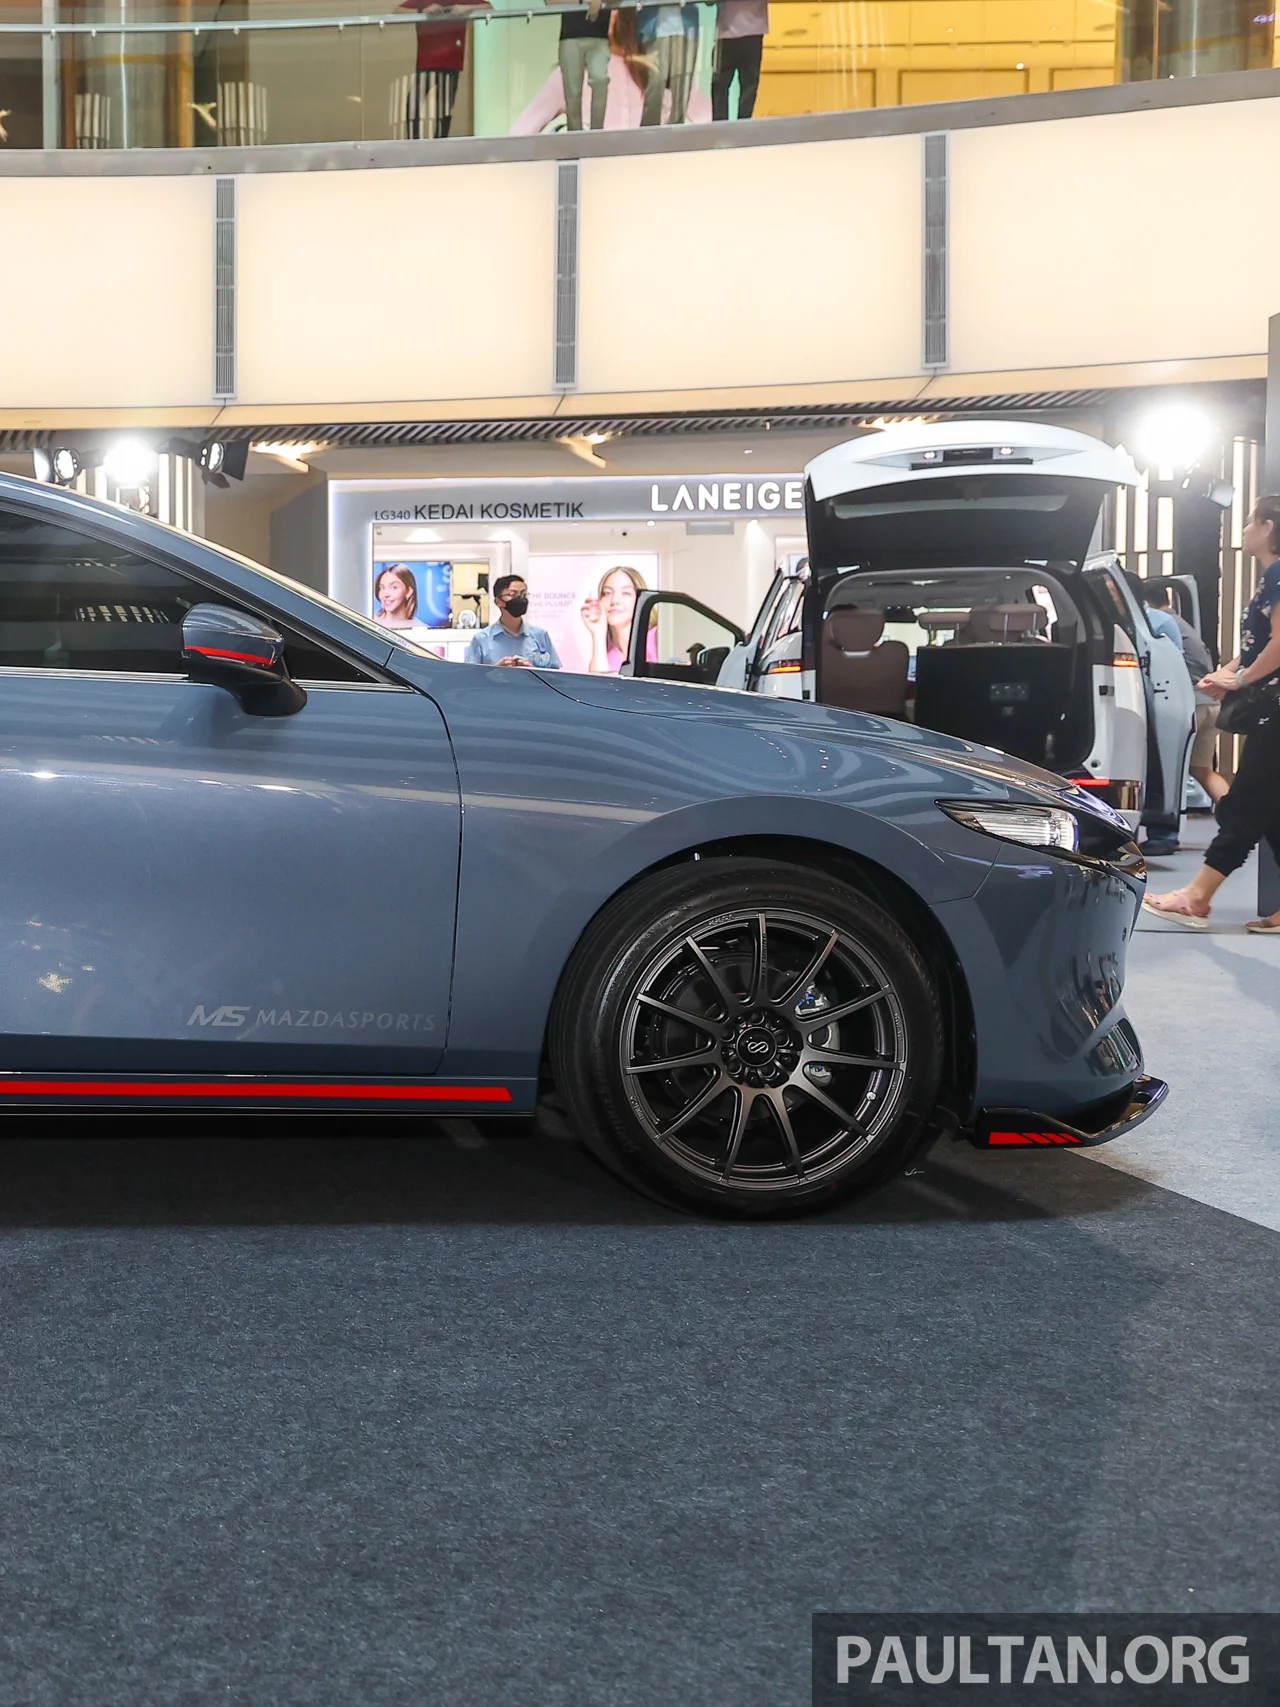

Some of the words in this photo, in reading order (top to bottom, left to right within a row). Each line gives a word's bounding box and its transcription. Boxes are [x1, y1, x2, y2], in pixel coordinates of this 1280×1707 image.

[651, 481, 803, 512] LANEIGE
[374, 509, 411, 521] LG340
[414, 504, 473, 520] KEDAI
[480, 502, 584, 519] KOSMETIK
[544, 592, 576, 600] BOUNCE
[186, 1004, 251, 1027] MS
[256, 1008, 436, 1032] MAZDASPORTS
